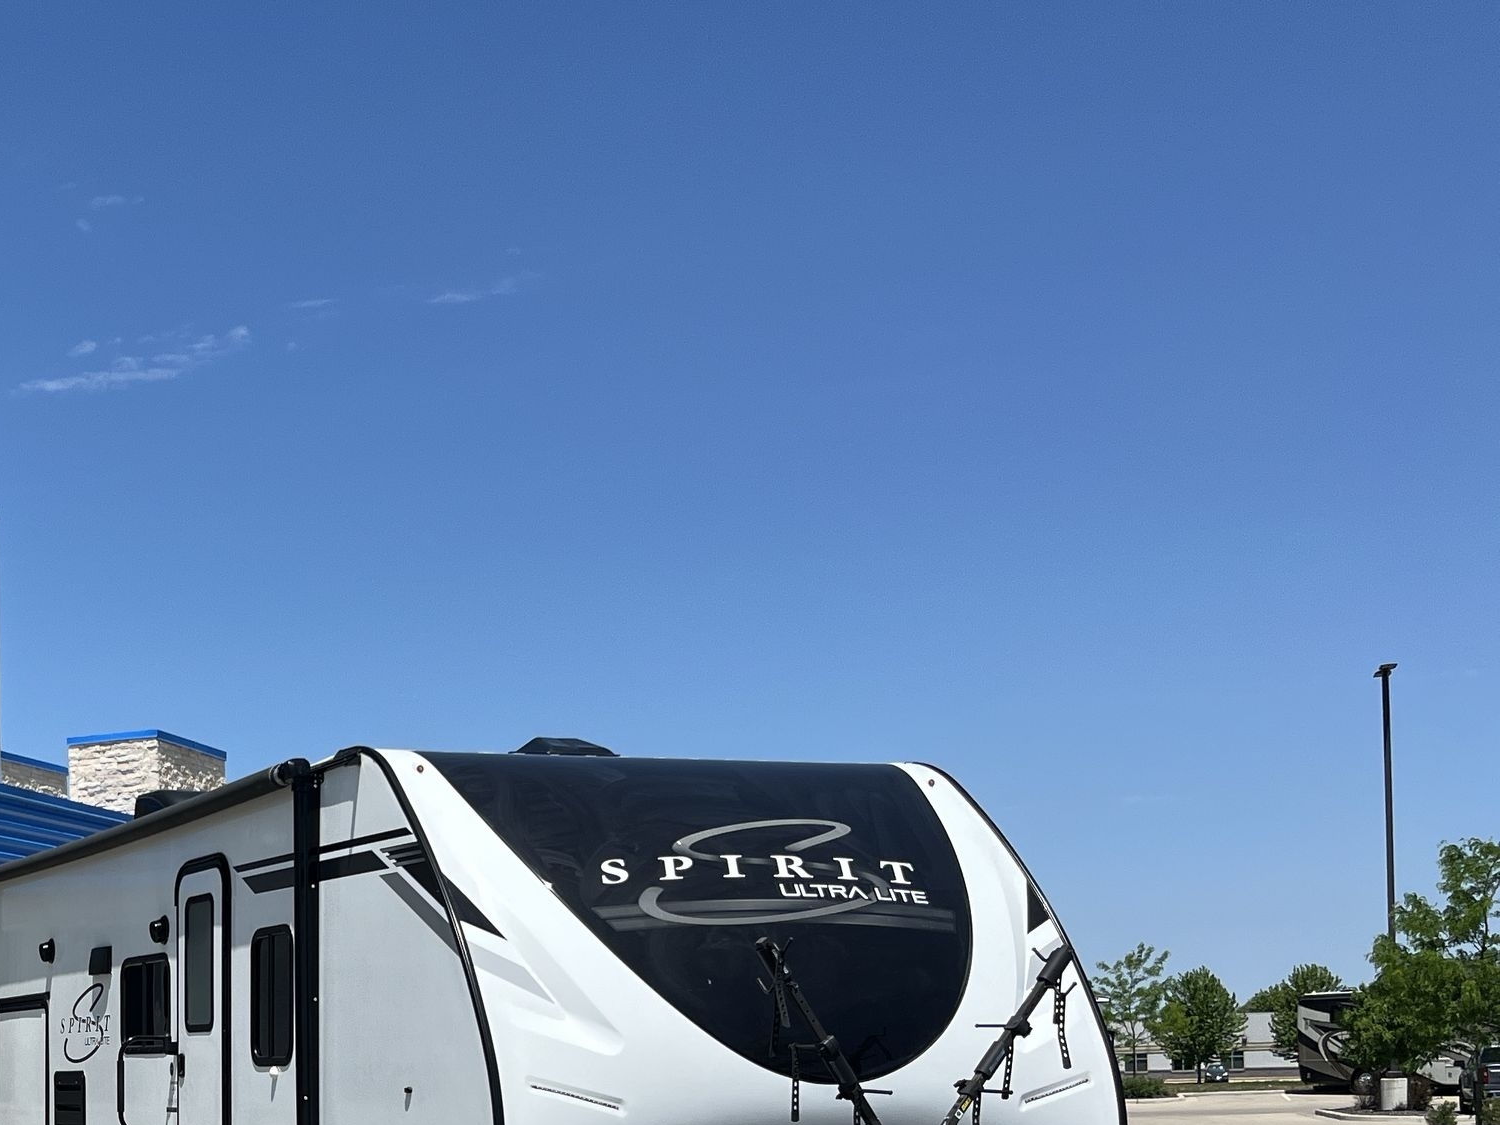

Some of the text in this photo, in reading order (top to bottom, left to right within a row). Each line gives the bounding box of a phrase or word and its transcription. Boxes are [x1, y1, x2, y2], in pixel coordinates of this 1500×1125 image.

[600, 855, 914, 885] SPIRIT
[779, 883, 929, 905] ULTRA LITE
[60, 1014, 111, 1034] SPIRIT
